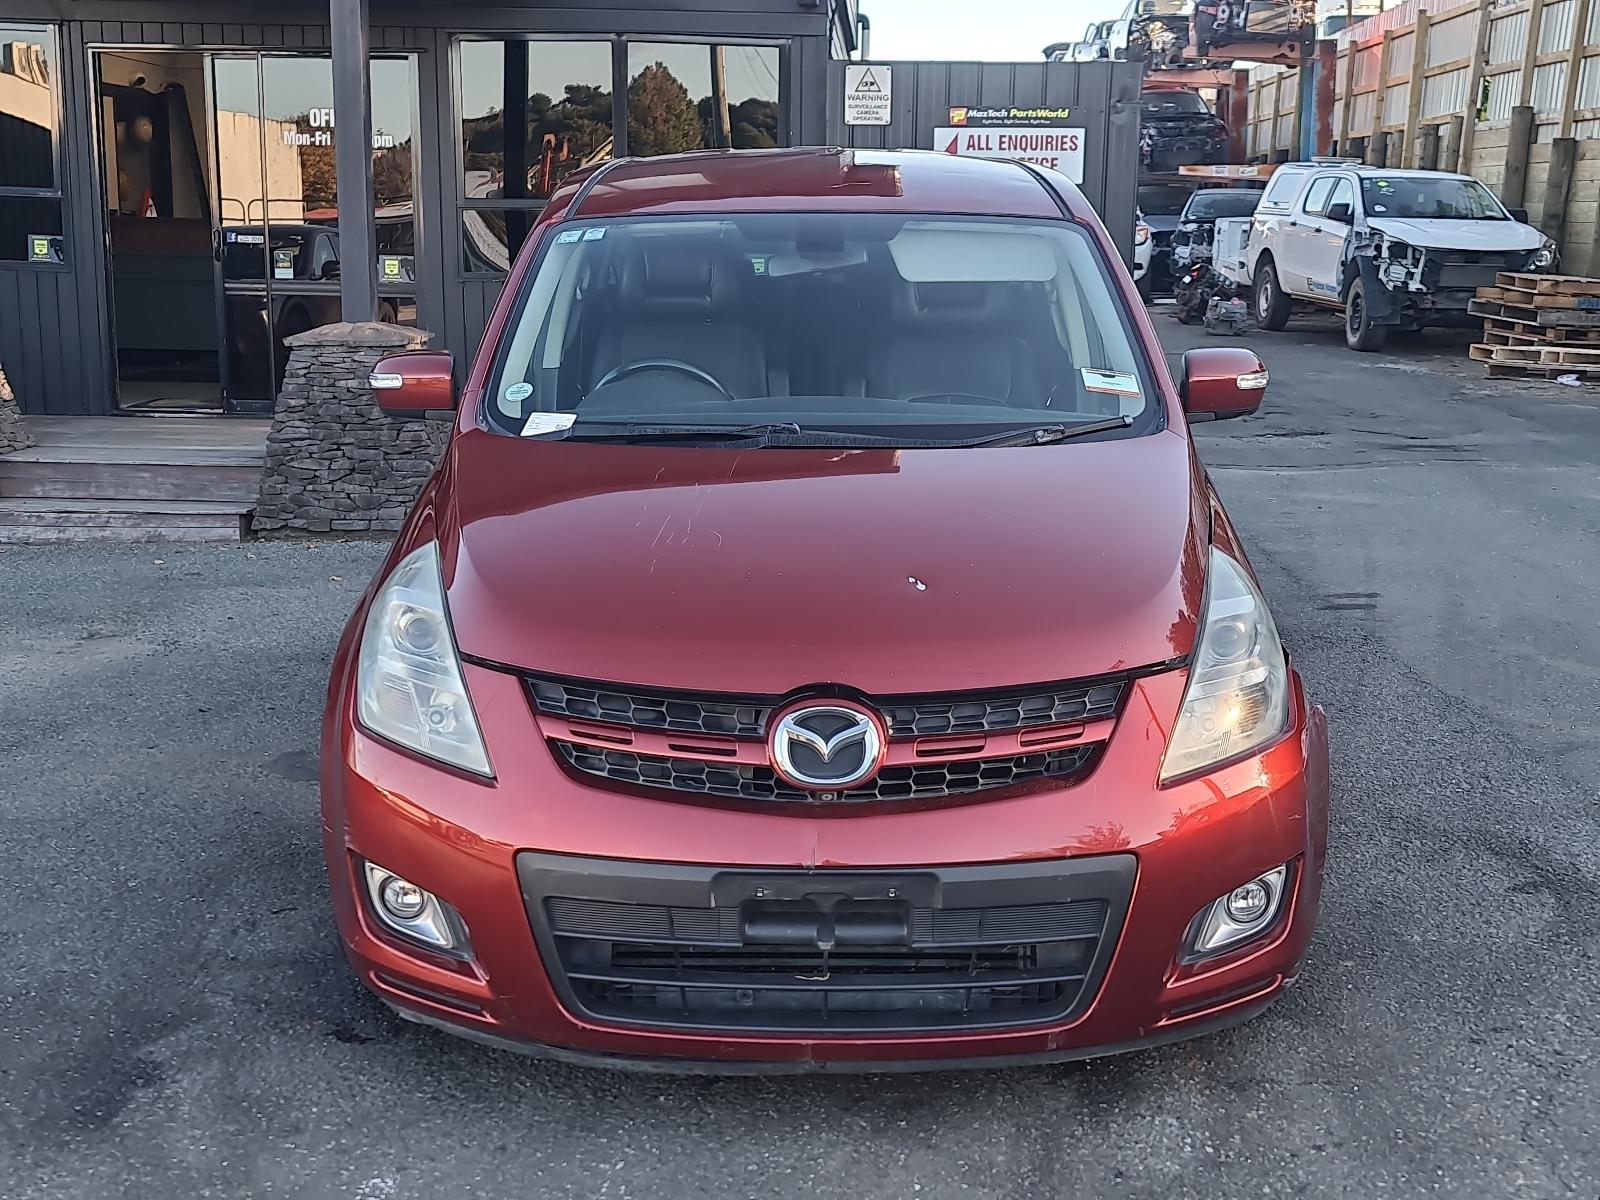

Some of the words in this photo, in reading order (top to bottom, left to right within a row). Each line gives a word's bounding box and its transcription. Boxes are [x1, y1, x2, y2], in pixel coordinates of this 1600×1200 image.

[1009, 108, 1070, 118] PartsWorld
[283, 131, 331, 146] Mon-Fri
[372, 135, 394, 148] pm
[966, 135, 993, 151] ALL
[998, 135, 1079, 153] ENQUIRIES
